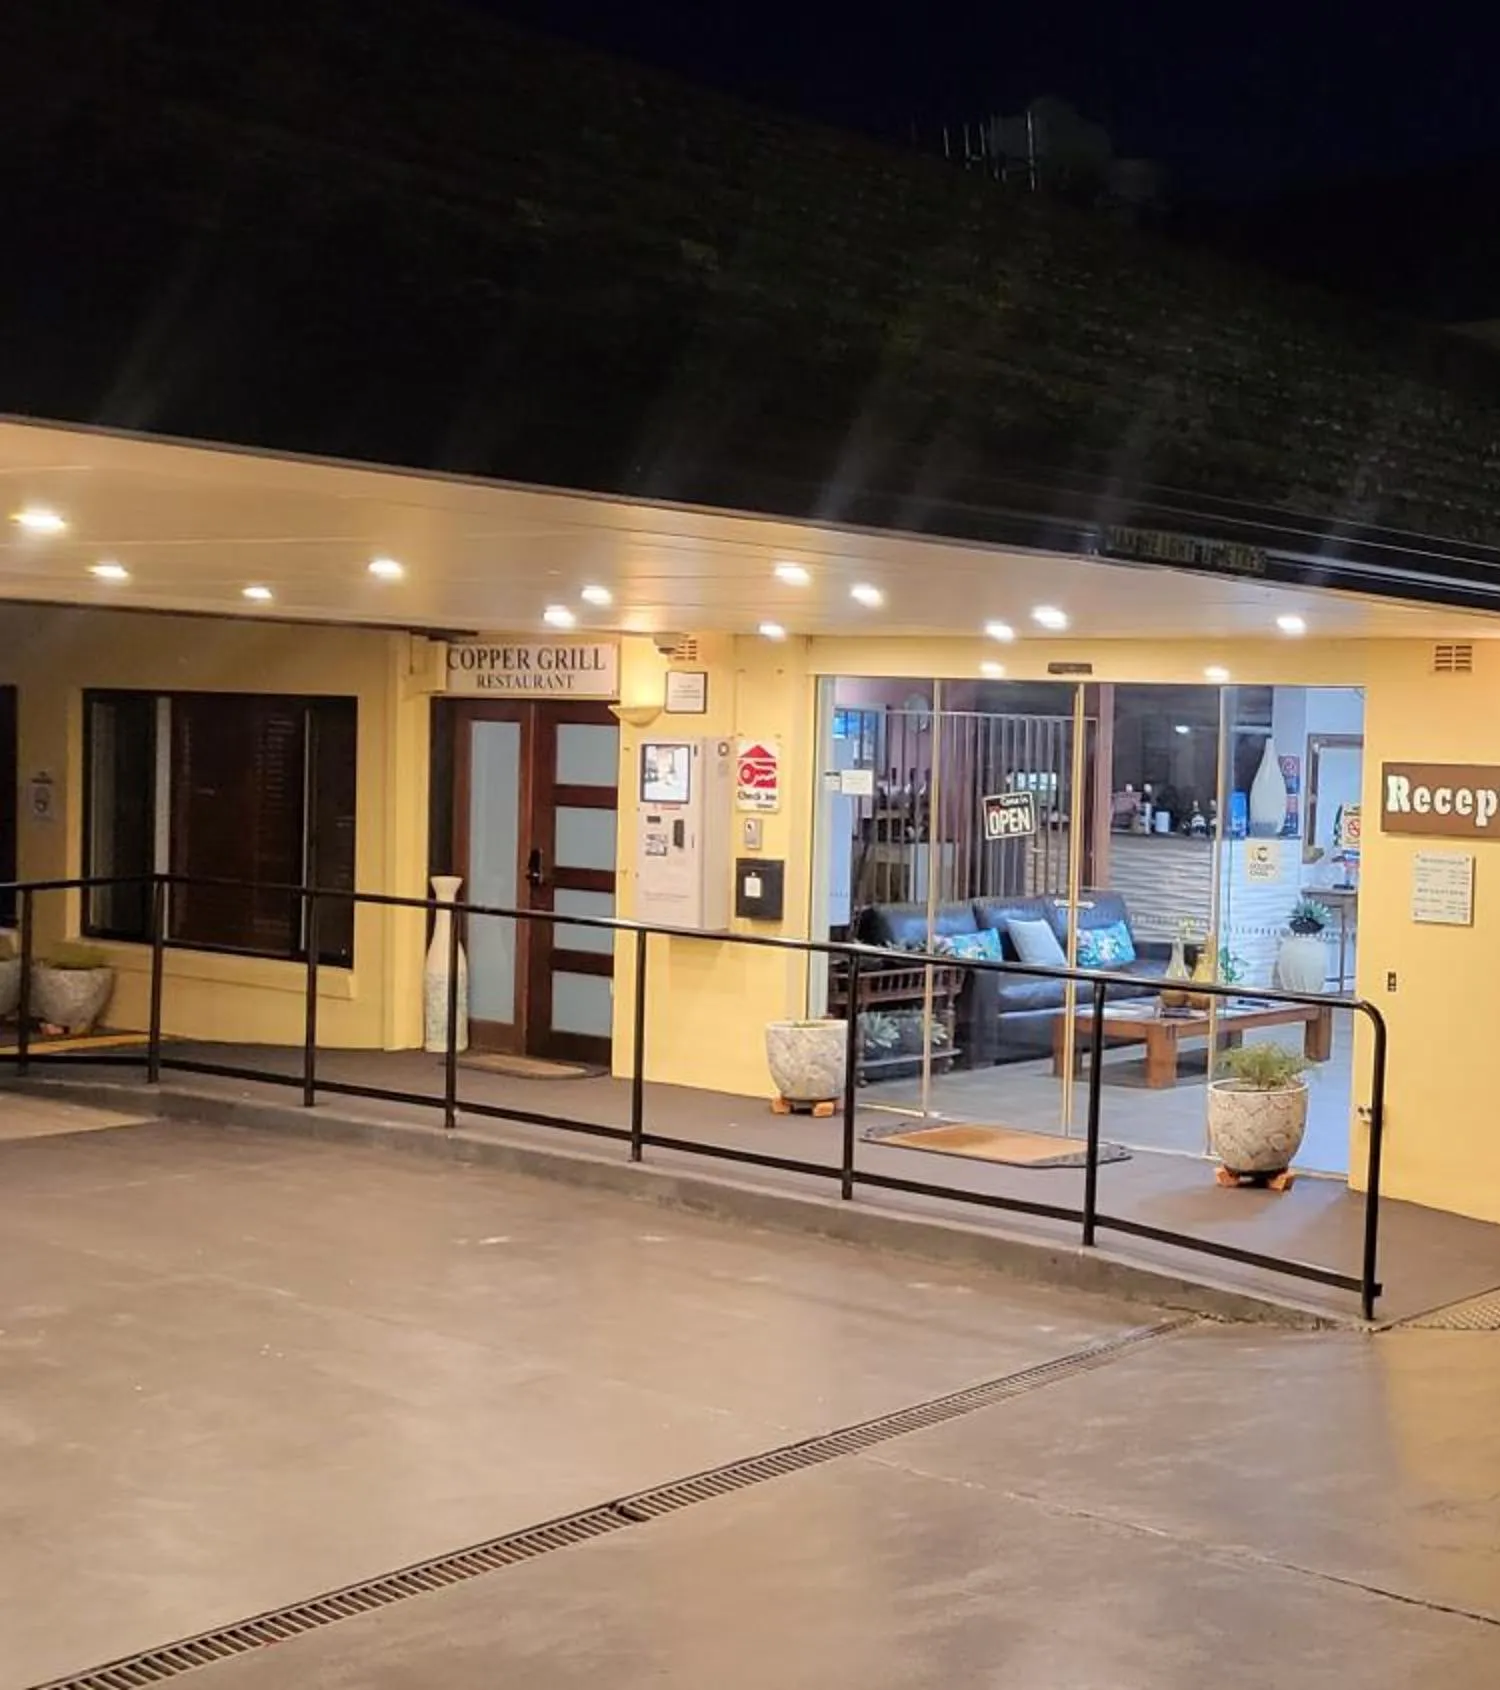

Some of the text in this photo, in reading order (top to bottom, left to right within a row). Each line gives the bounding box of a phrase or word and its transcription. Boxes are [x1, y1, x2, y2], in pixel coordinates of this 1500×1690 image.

[446, 647, 606, 671] COPPER GRILL
[477, 674, 574, 689] RESTAURANT
[990, 807, 1030, 834] OPEN
